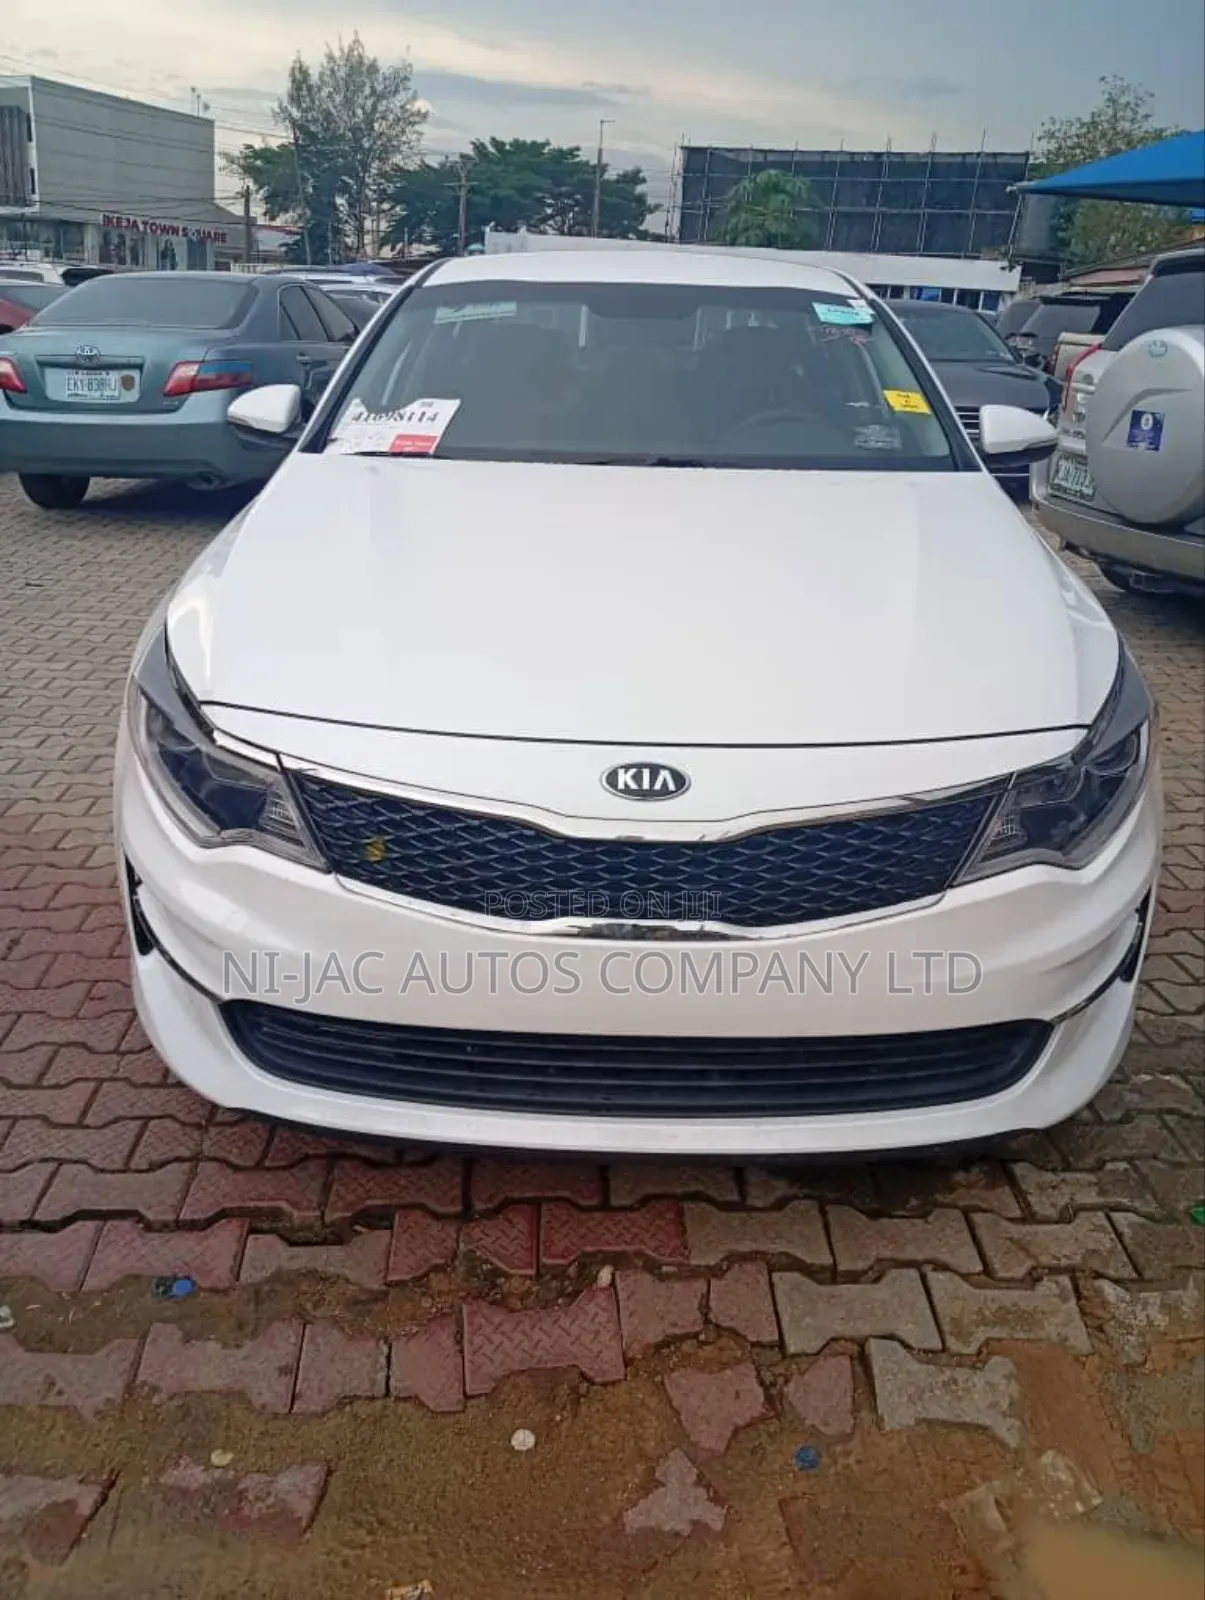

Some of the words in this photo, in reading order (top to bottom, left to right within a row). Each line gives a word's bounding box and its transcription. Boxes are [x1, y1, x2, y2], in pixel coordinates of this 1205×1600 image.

[102, 214, 140, 232] IKEJA
[141, 220, 180, 237] TOWN
[617, 768, 677, 791] KIA
